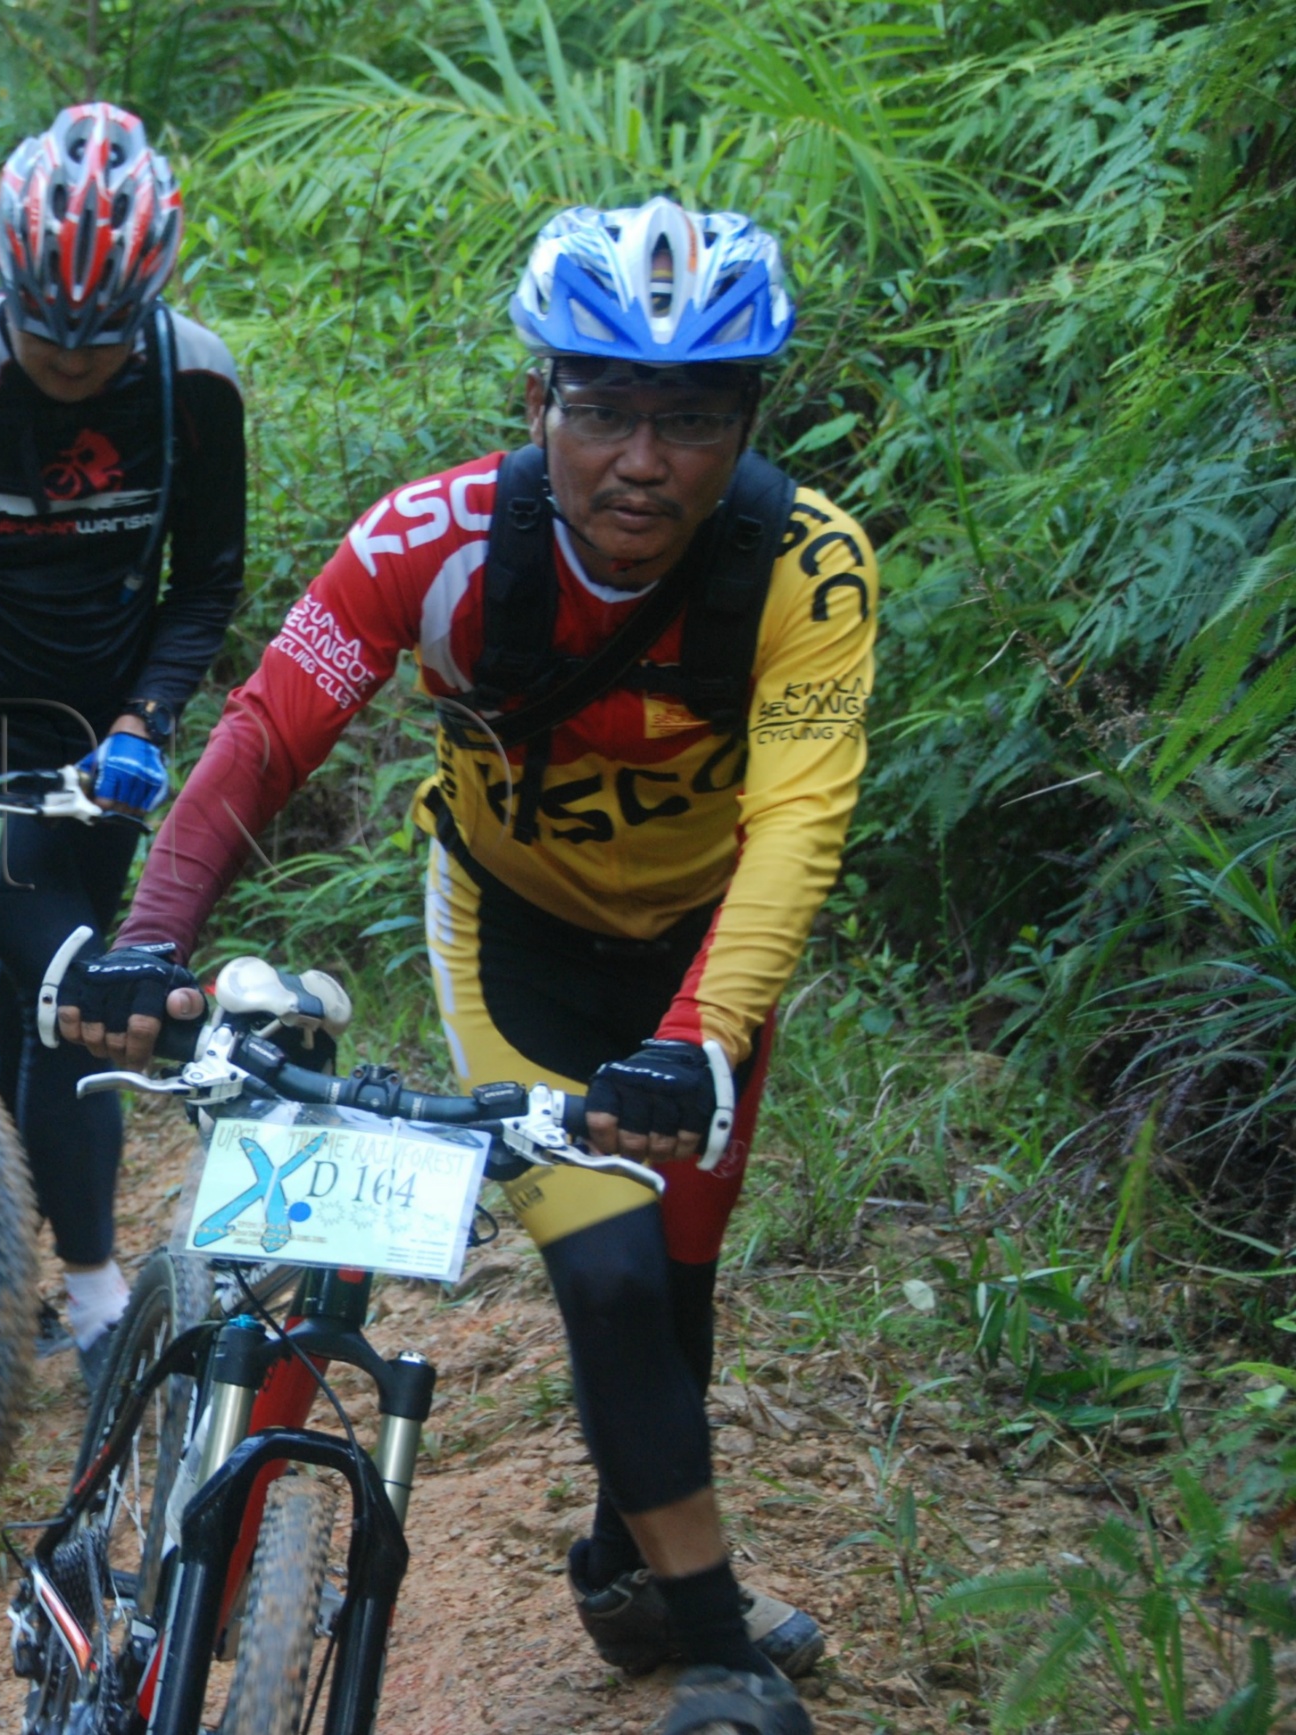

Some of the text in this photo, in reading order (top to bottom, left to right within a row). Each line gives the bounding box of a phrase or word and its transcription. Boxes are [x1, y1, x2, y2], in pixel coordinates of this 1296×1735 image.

[609, 1062, 676, 1081] SCOTT
[306, 1160, 417, 1208] D 164
